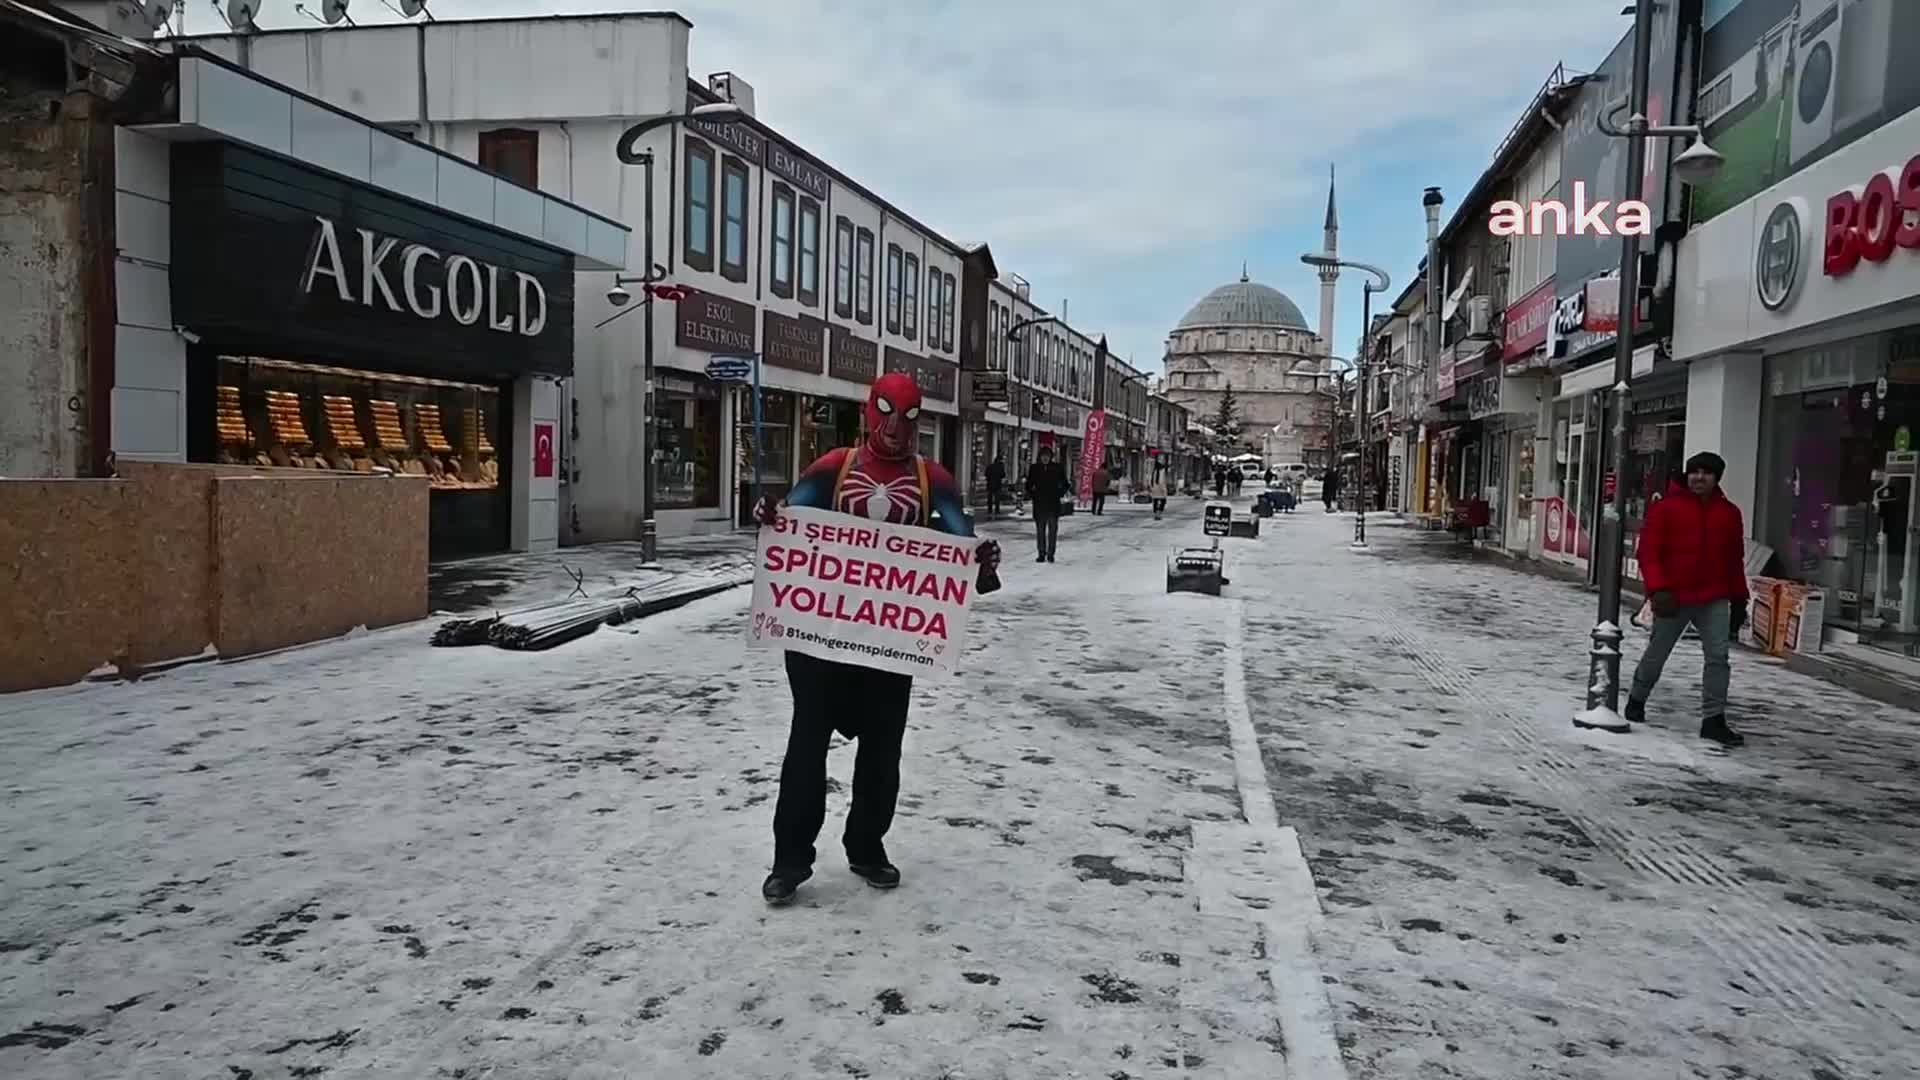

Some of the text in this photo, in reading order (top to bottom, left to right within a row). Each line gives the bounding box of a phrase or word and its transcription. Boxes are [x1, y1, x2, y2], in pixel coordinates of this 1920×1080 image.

[775, 151, 823, 192] EMLAK
[302, 216, 547, 336] AKGOLD
[706, 302, 735, 323] EKOL
[804, 523, 880, 549] ŞEHRİ
[885, 535, 970, 566] GEZEN
[764, 545, 968, 605] SPİDERMAN
[769, 582, 947, 640] YOLLARDA
